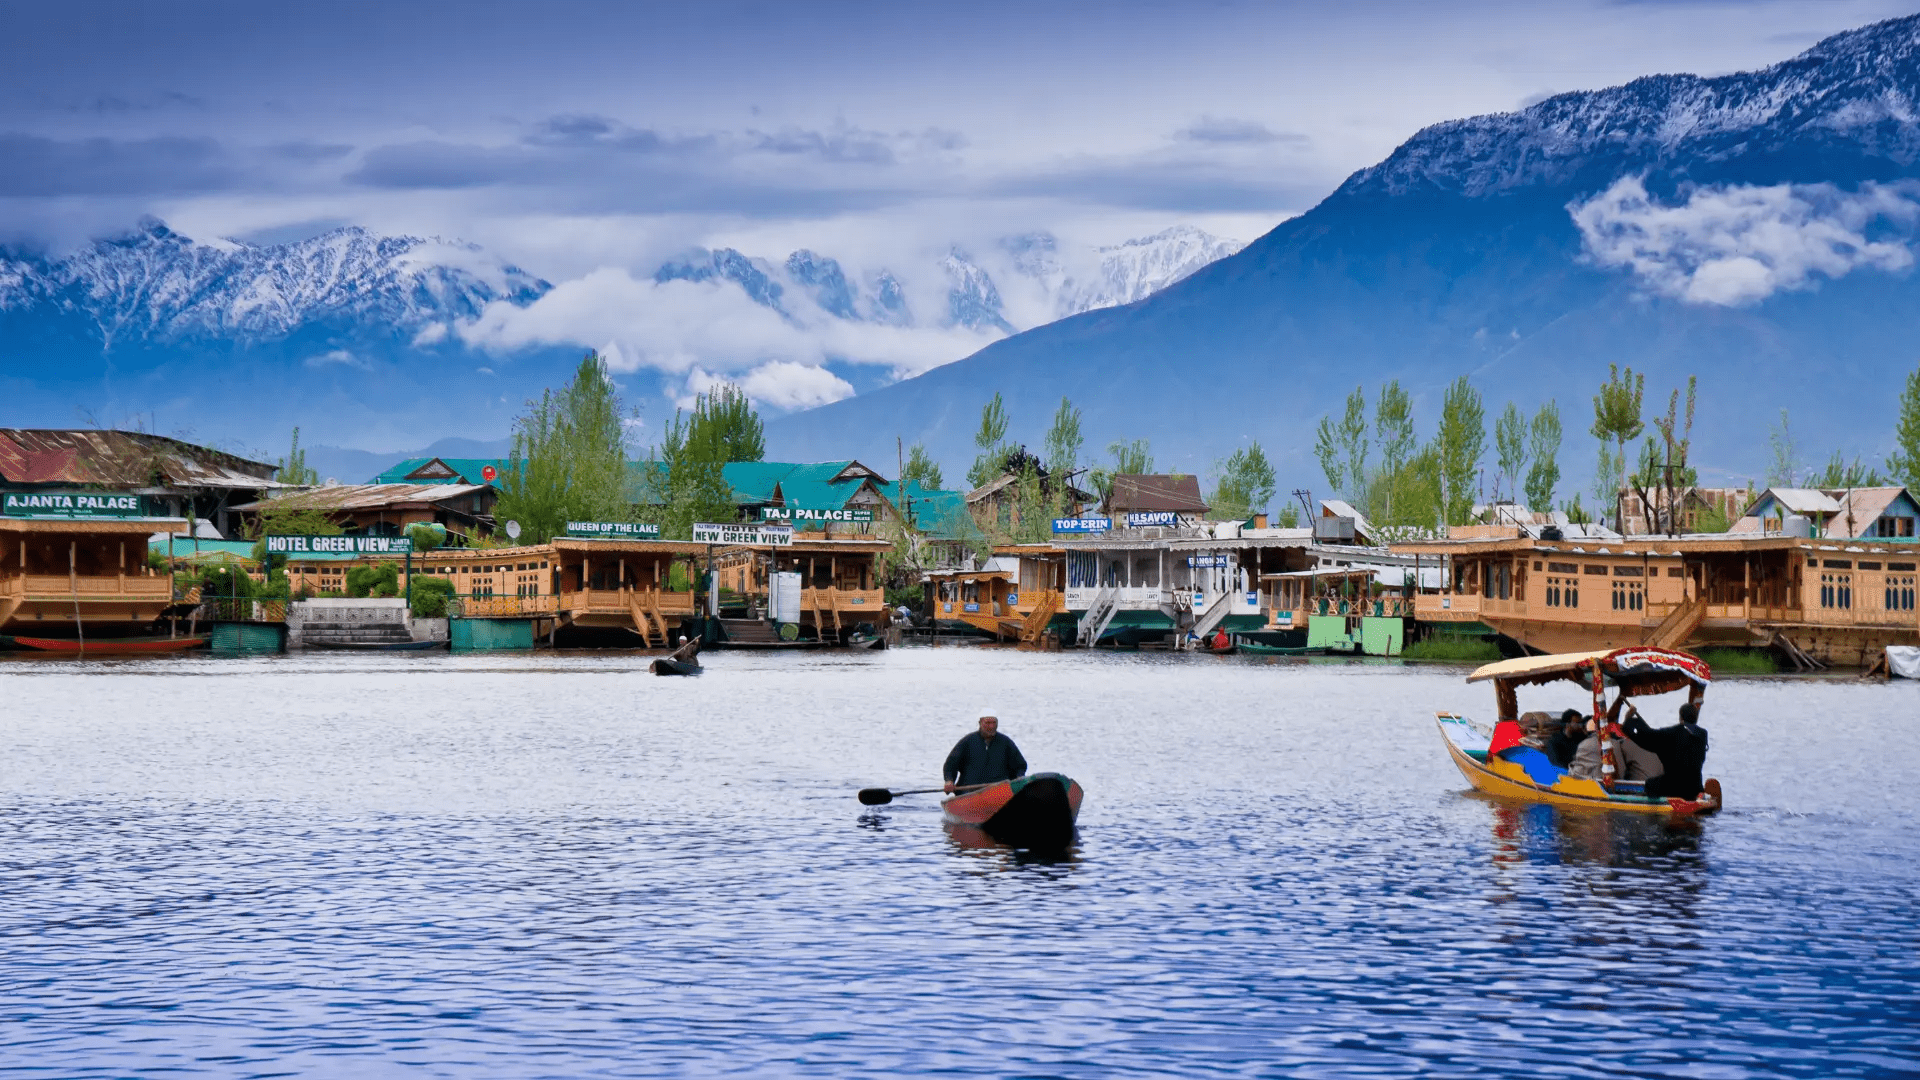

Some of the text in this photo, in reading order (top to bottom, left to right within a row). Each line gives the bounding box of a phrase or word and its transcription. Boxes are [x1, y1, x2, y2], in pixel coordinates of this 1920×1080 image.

[7, 495, 137, 509] AJANTA PALACE
[764, 508, 852, 520] TAJ PALACE
[1140, 512, 1175, 522] SAVOY
[568, 522, 659, 533] QUEEN OF THE LAKE
[1056, 520, 1108, 529] TOP-ERIN
[268, 536, 389, 552] HOTEL GREEN VIEW
[695, 531, 790, 545] NEW GREEN VIEW
